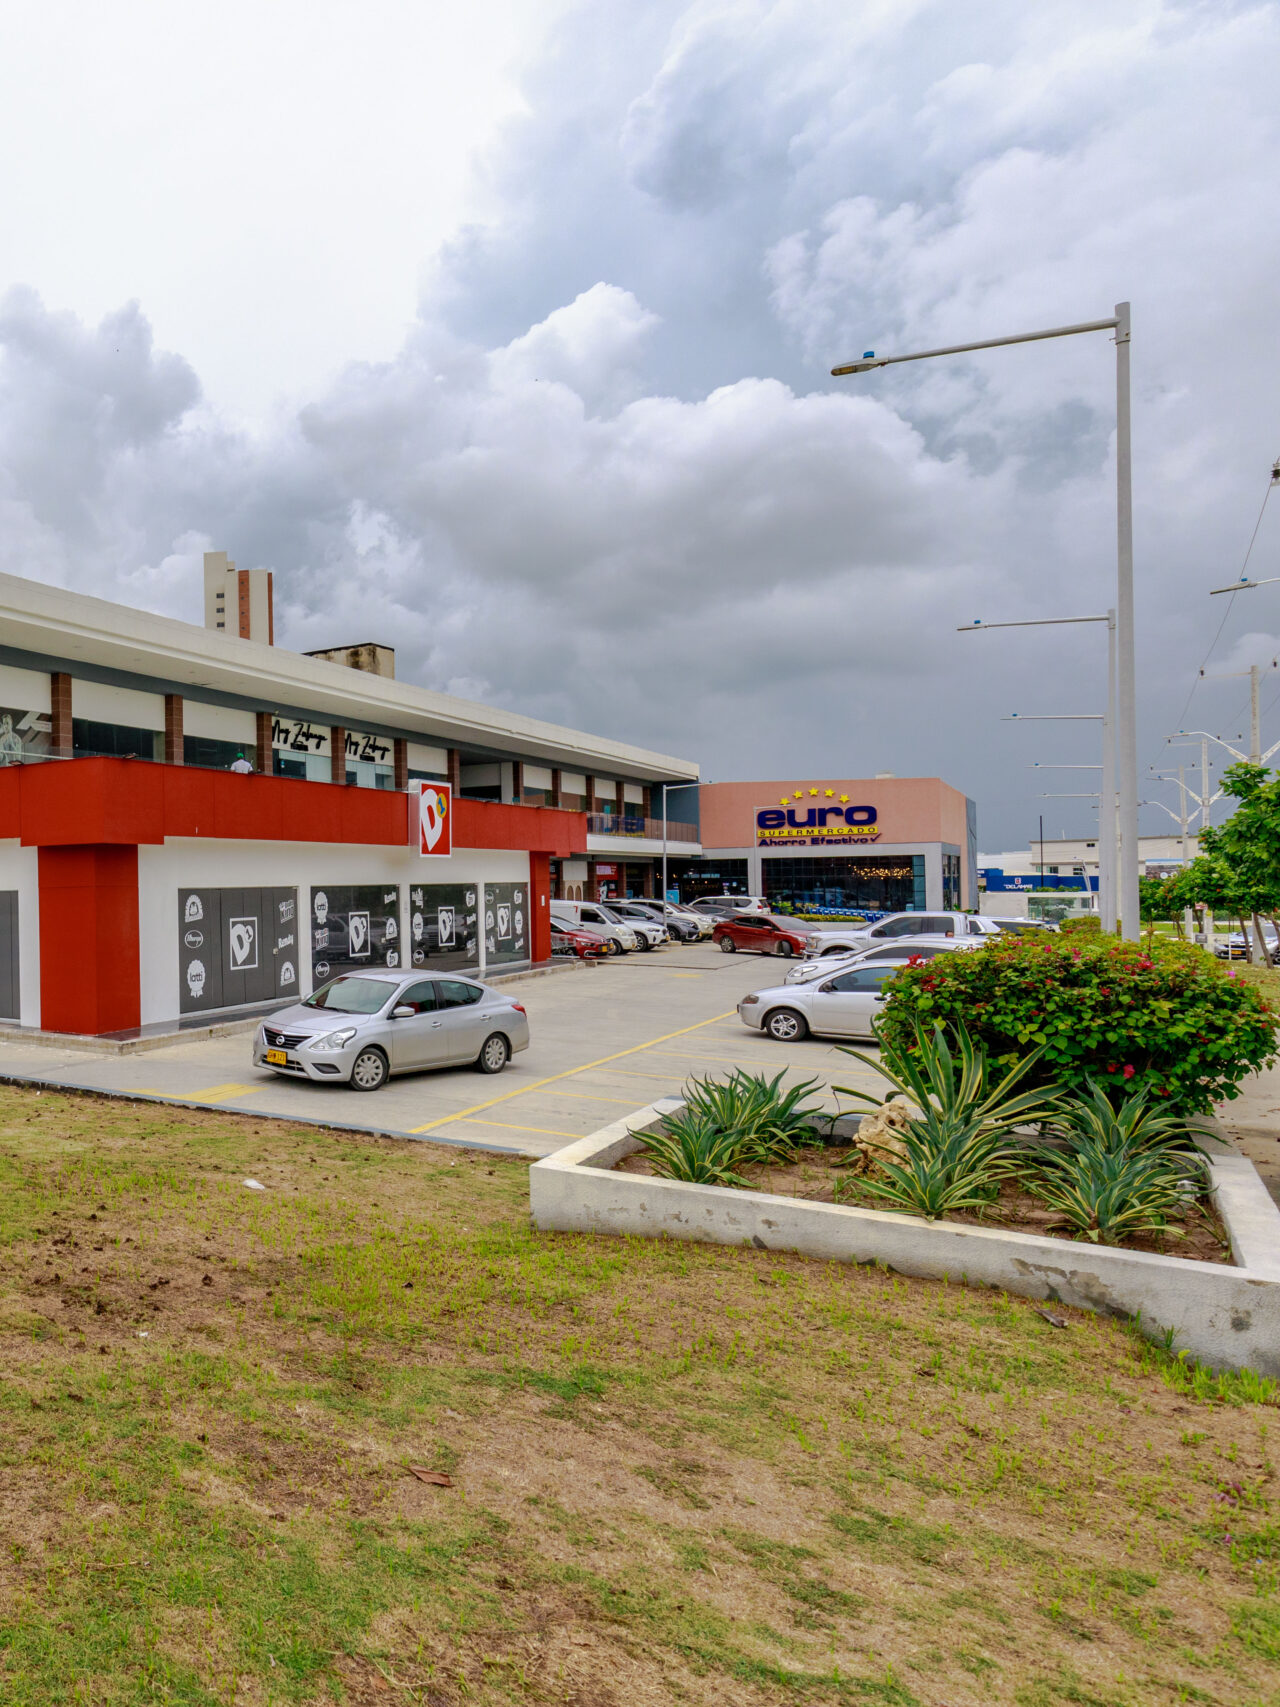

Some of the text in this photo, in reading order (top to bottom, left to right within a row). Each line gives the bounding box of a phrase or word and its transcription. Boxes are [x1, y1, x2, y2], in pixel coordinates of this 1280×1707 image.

[757, 805, 877, 829] euro
[760, 827, 876, 837] SUPERMERCADO
[759, 836, 869, 847] Ahorro Efectivo
